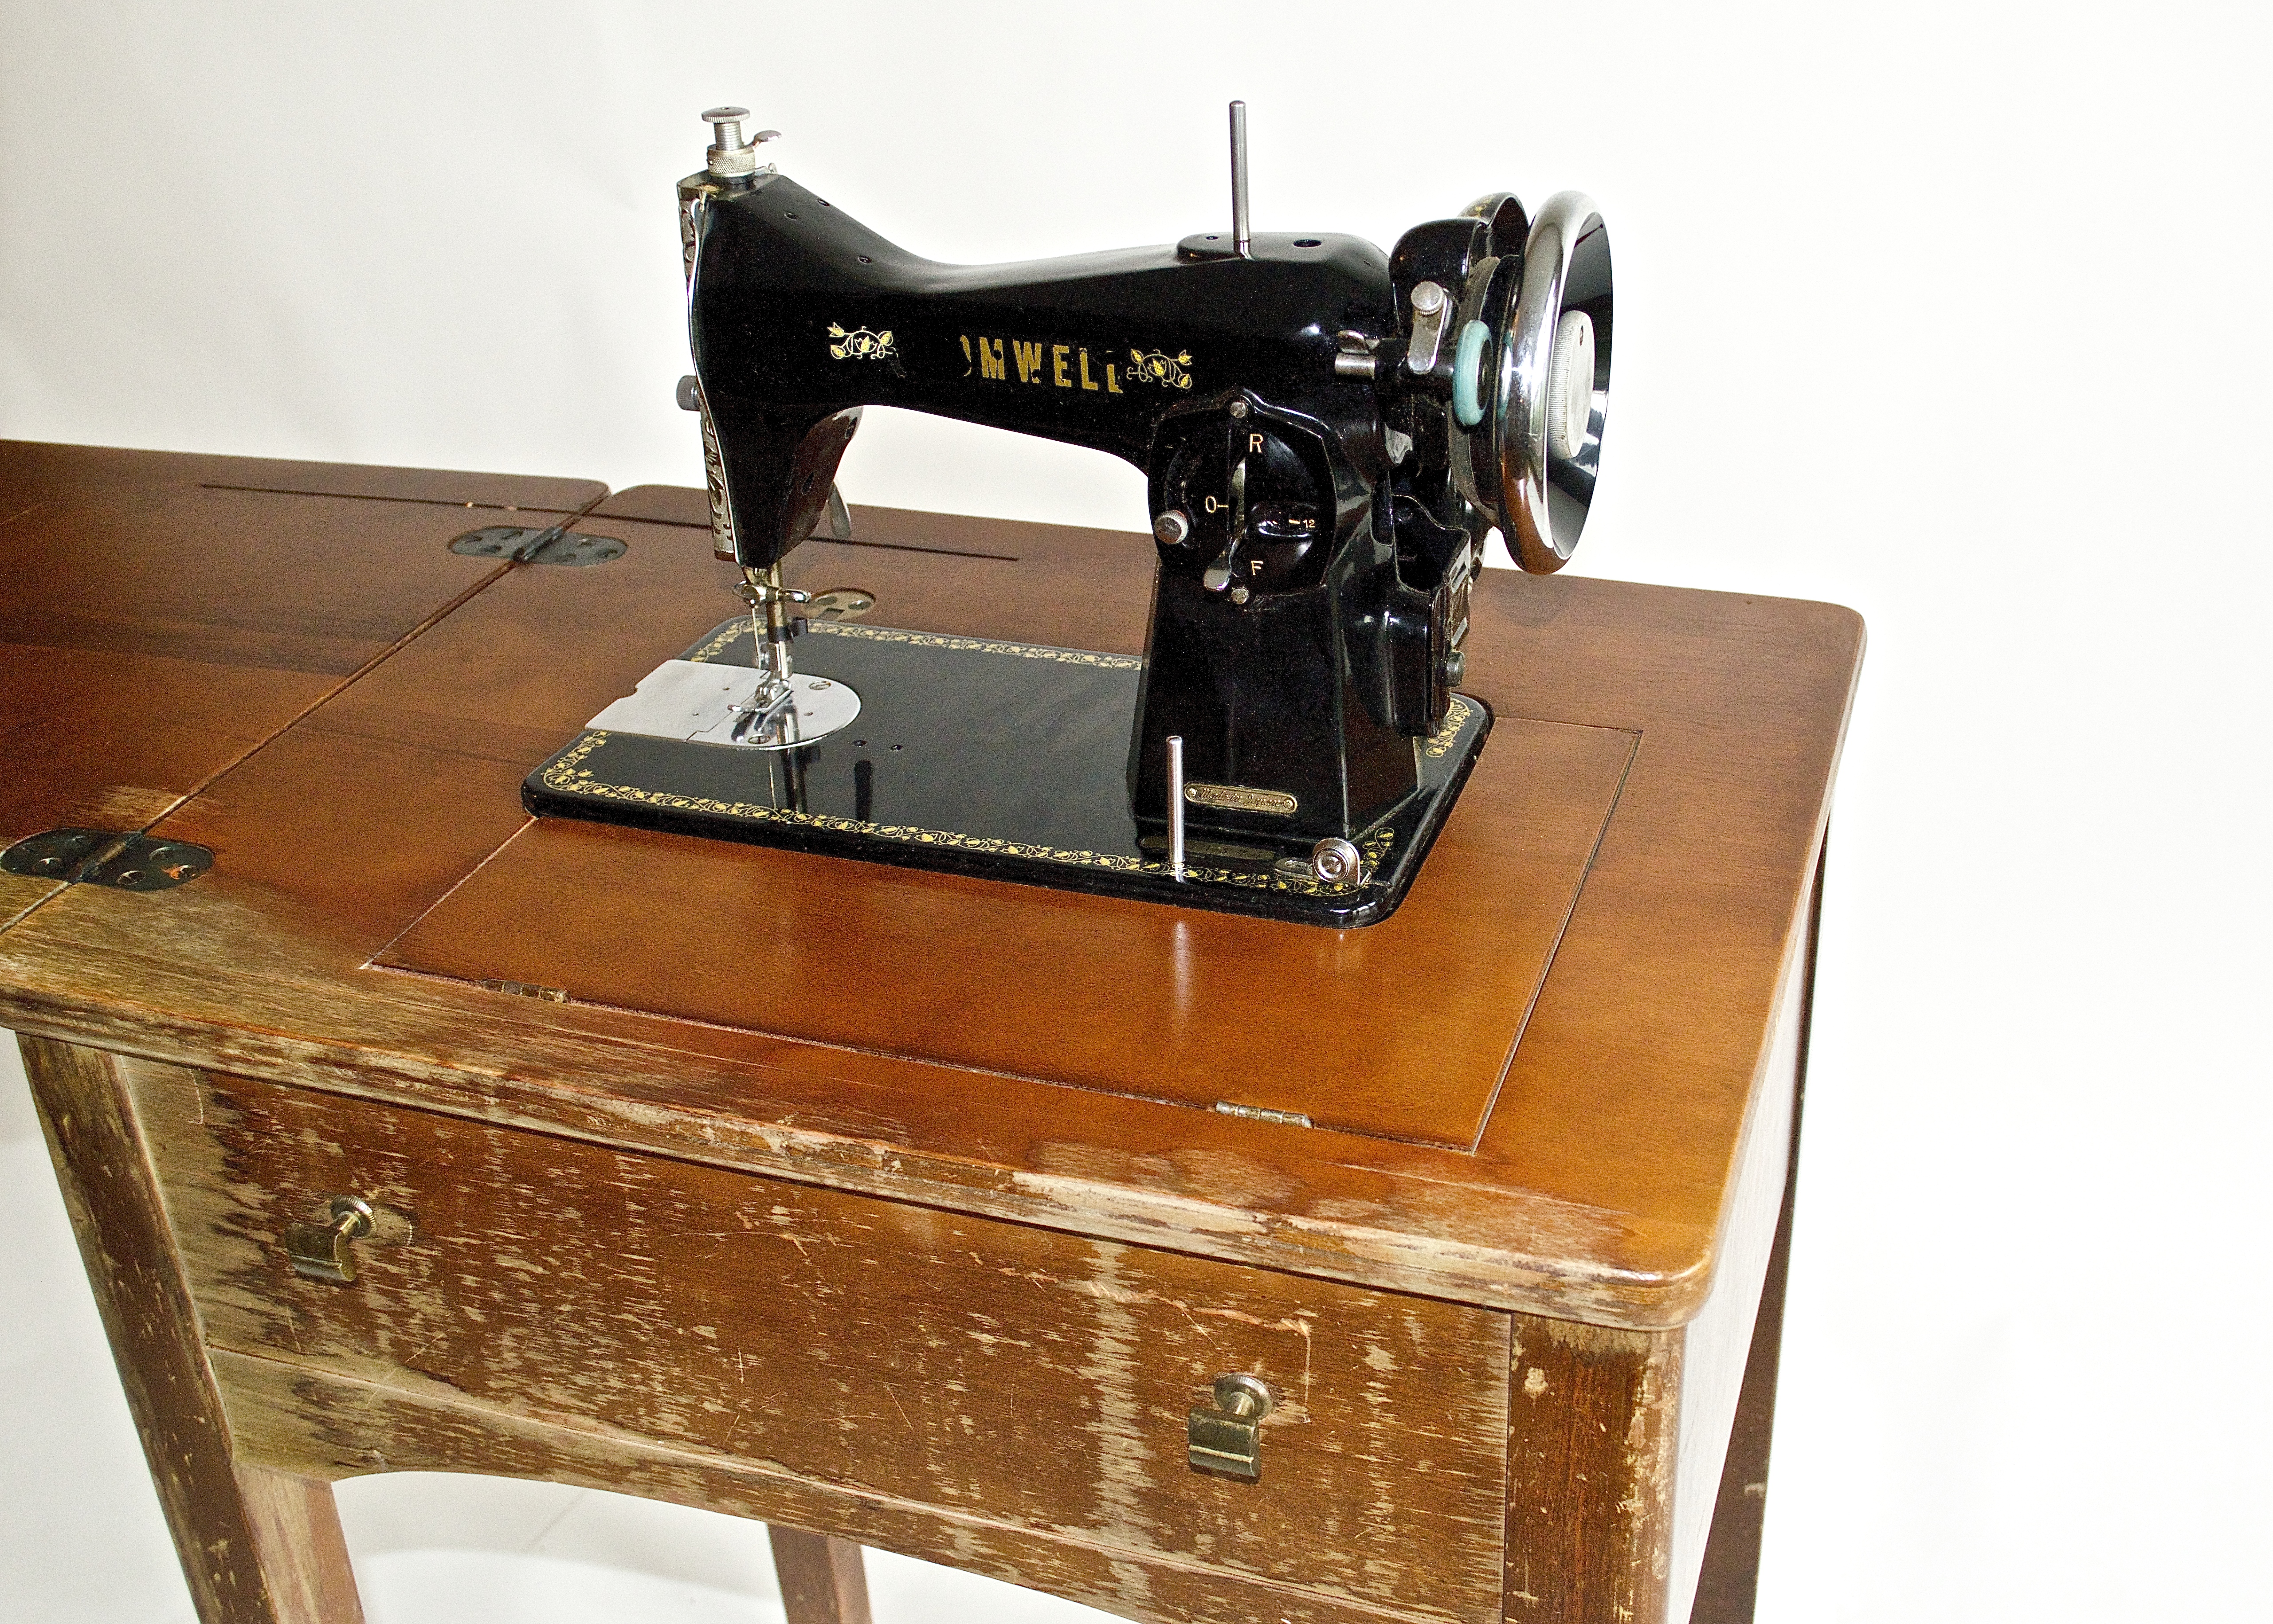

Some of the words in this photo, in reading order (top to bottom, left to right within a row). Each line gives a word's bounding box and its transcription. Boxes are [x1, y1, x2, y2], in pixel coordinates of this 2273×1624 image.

[960, 335, 1124, 393] MWELL
[1249, 433, 1264, 453] R
[1303, 519, 1315, 528] 12
[1251, 560, 1264, 576] F
